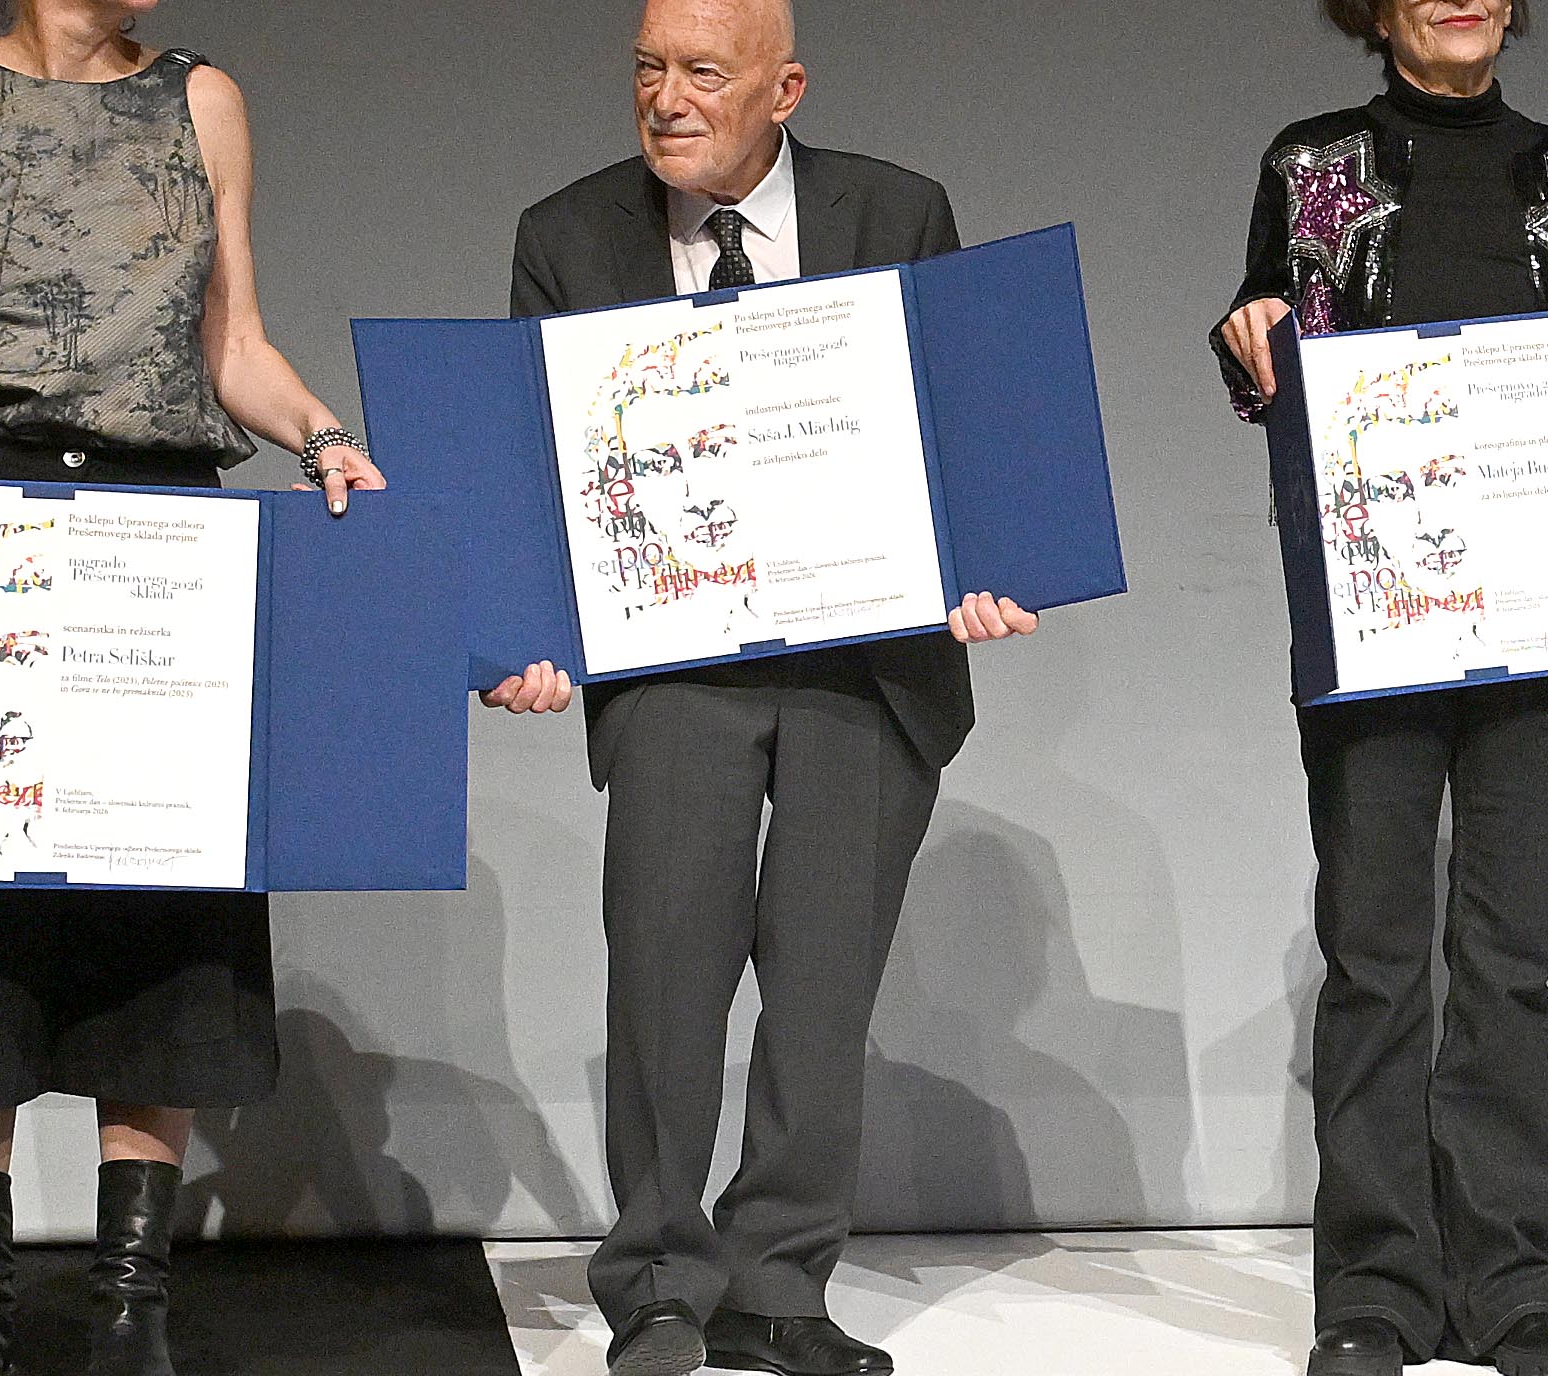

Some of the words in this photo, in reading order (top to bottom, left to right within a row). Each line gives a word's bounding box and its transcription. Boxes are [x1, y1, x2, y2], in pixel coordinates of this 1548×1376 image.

[799, 415, 860, 435] Mächtig
[69, 514, 81, 523] Po
[85, 515, 114, 526] sklepu
[118, 516, 168, 530] Upravnega
[172, 520, 205, 530] odbora
[69, 527, 131, 540] Prešernovega
[134, 531, 162, 540] sklada
[166, 533, 198, 543] prejme
[69, 556, 126, 571] nagrado
[73, 568, 167, 590] Prešernovega
[172, 578, 202, 590] 2026
[130, 585, 173, 600] sklada
[62, 646, 104, 663] Petra
[109, 648, 175, 666] Seliškar
